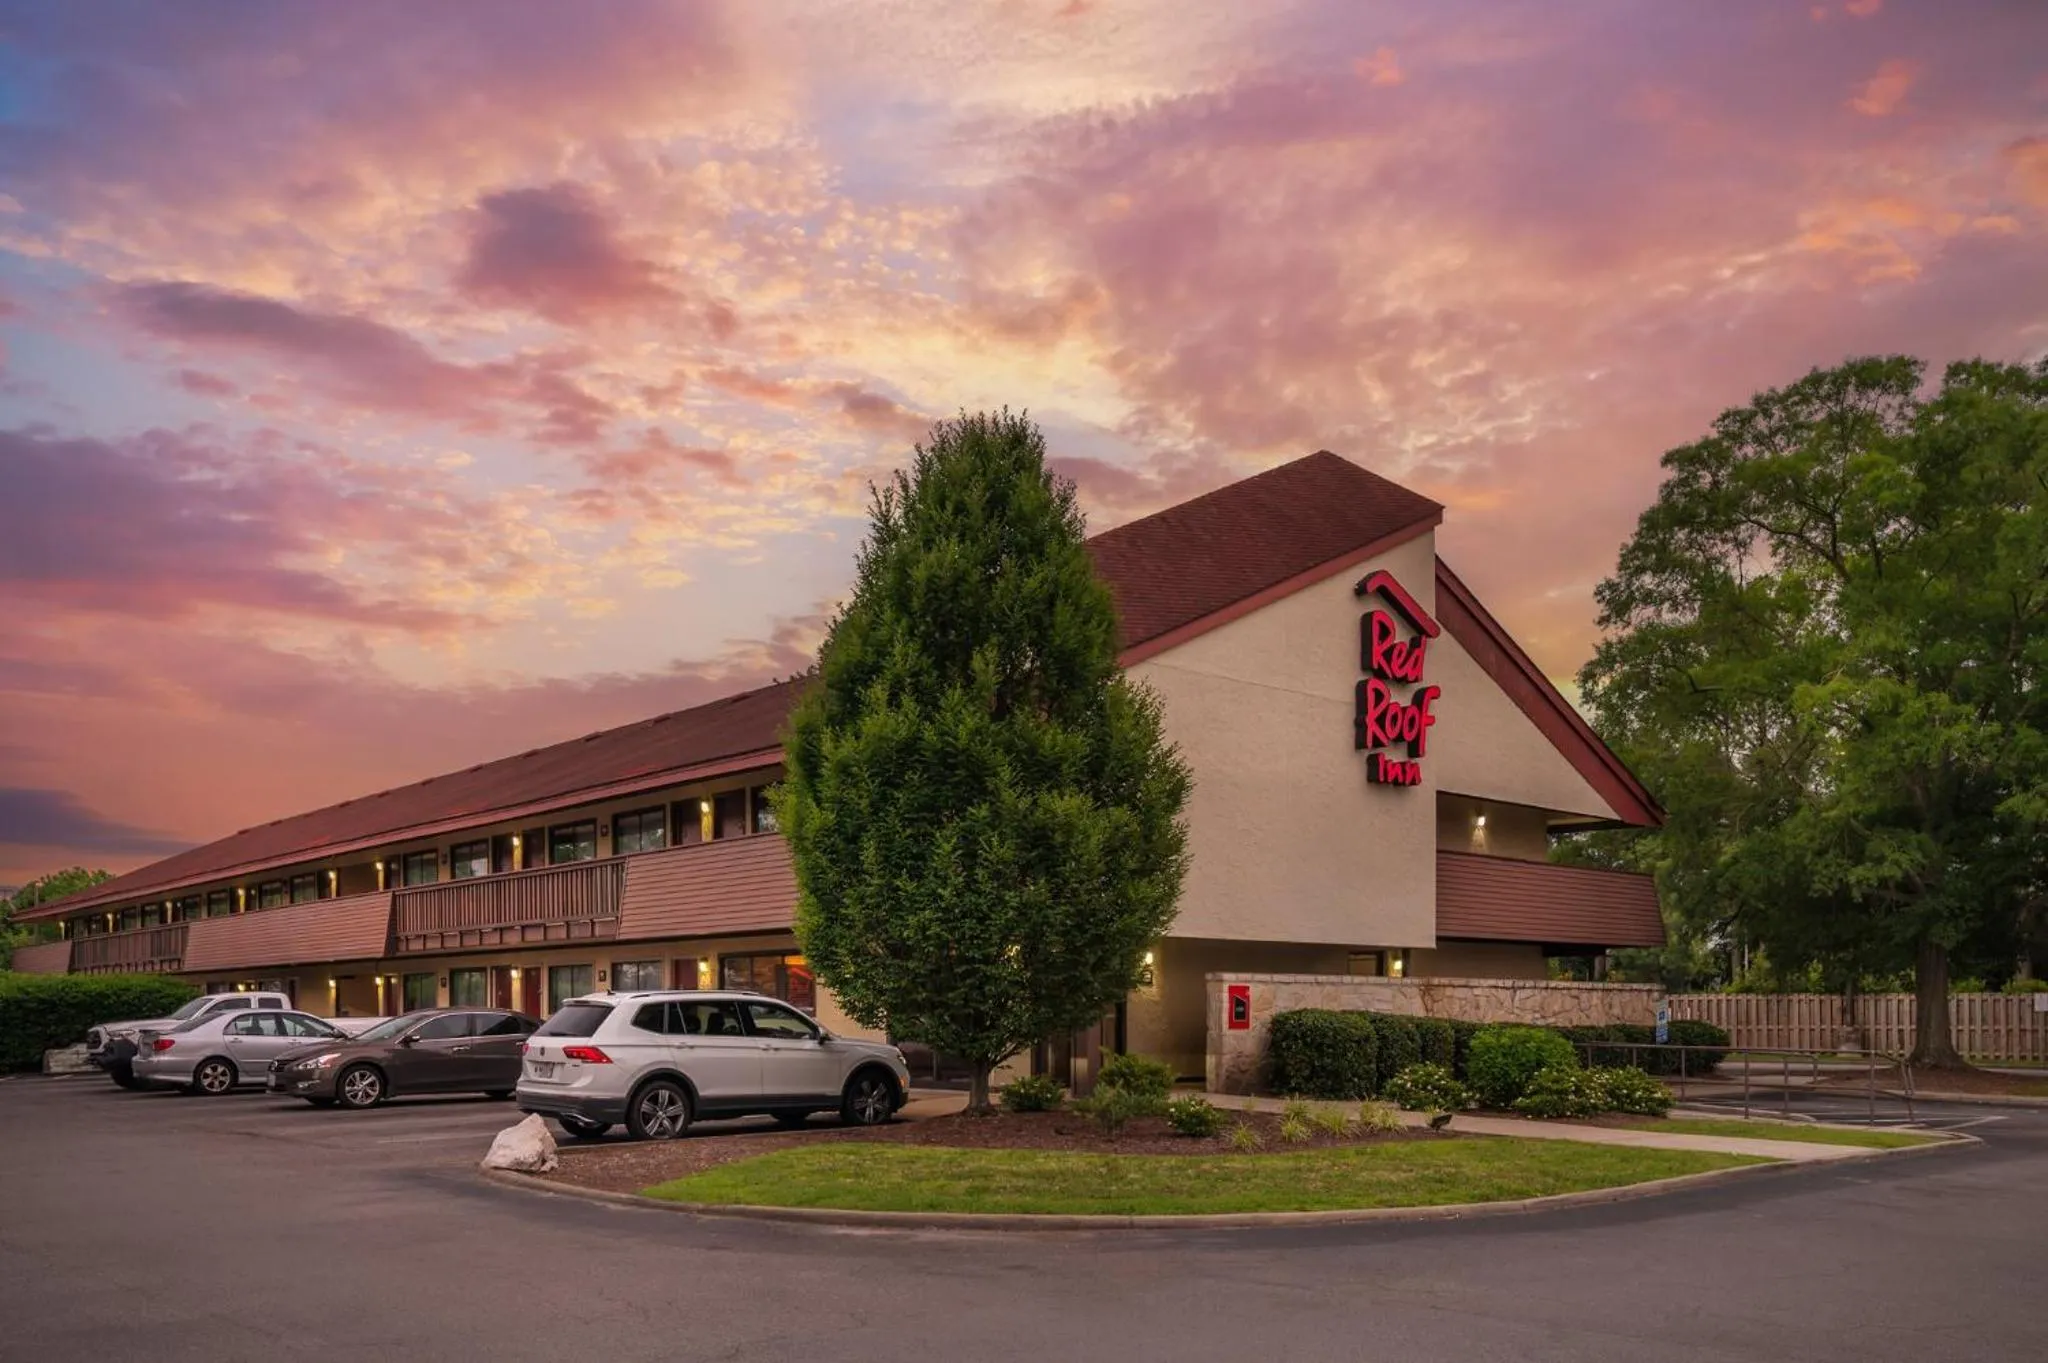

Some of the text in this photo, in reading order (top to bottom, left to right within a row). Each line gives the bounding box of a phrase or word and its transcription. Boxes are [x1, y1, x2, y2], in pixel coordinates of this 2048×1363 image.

[1371, 610, 1427, 684] Red
[1366, 677, 1441, 758] Roof
[1377, 752, 1422, 786] Inn
